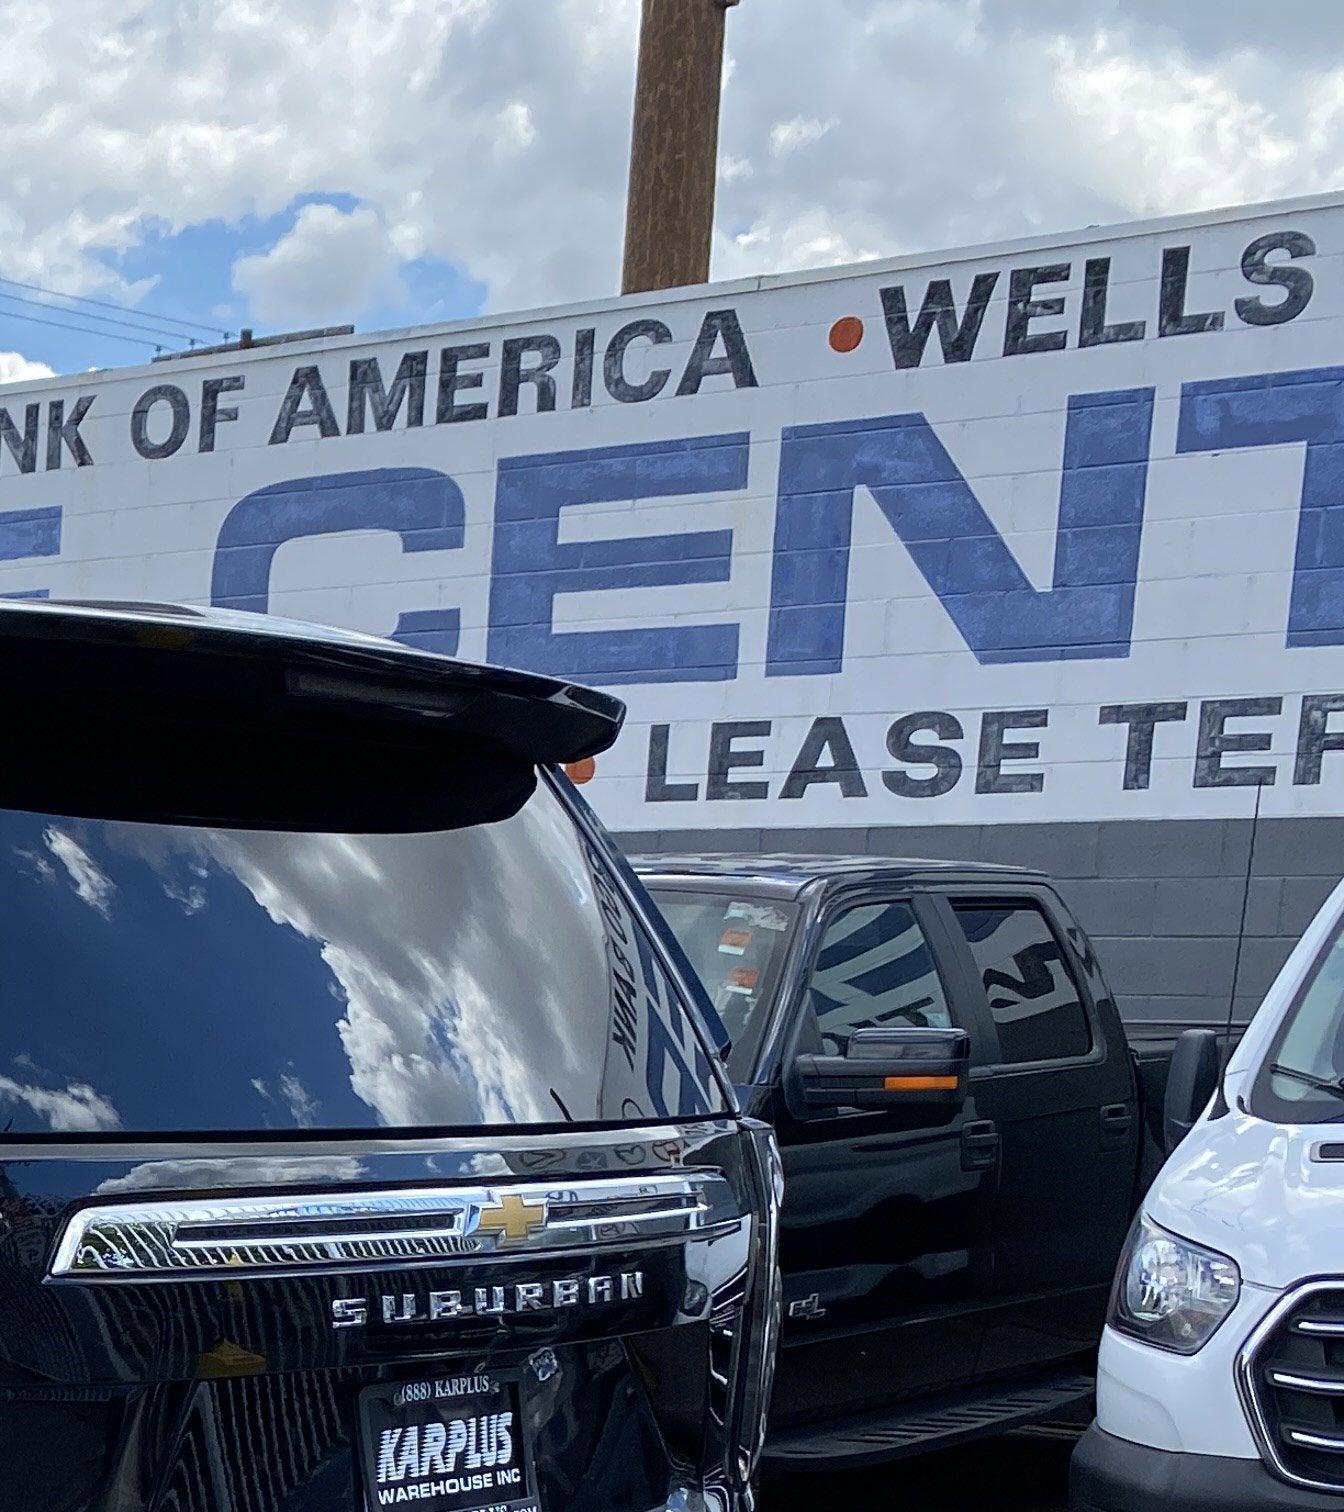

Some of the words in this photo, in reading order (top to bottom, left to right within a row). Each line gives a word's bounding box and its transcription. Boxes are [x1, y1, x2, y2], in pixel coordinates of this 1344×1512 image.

[131, 375, 245, 460] OF
[268, 308, 760, 446] AMERICA
[878, 231, 1317, 370] WELLS
[644, 709, 1051, 803] LEASE
[332, 1271, 644, 1329] SUBURBAN
[400, 1382, 432, 1403] (888)
[434, 1375, 490, 1398] KARPLUS
[376, 1411, 513, 1483] KARPLUS
[378, 1472, 494, 1505] WAREHOUSE
[497, 1468, 521, 1486] INC
